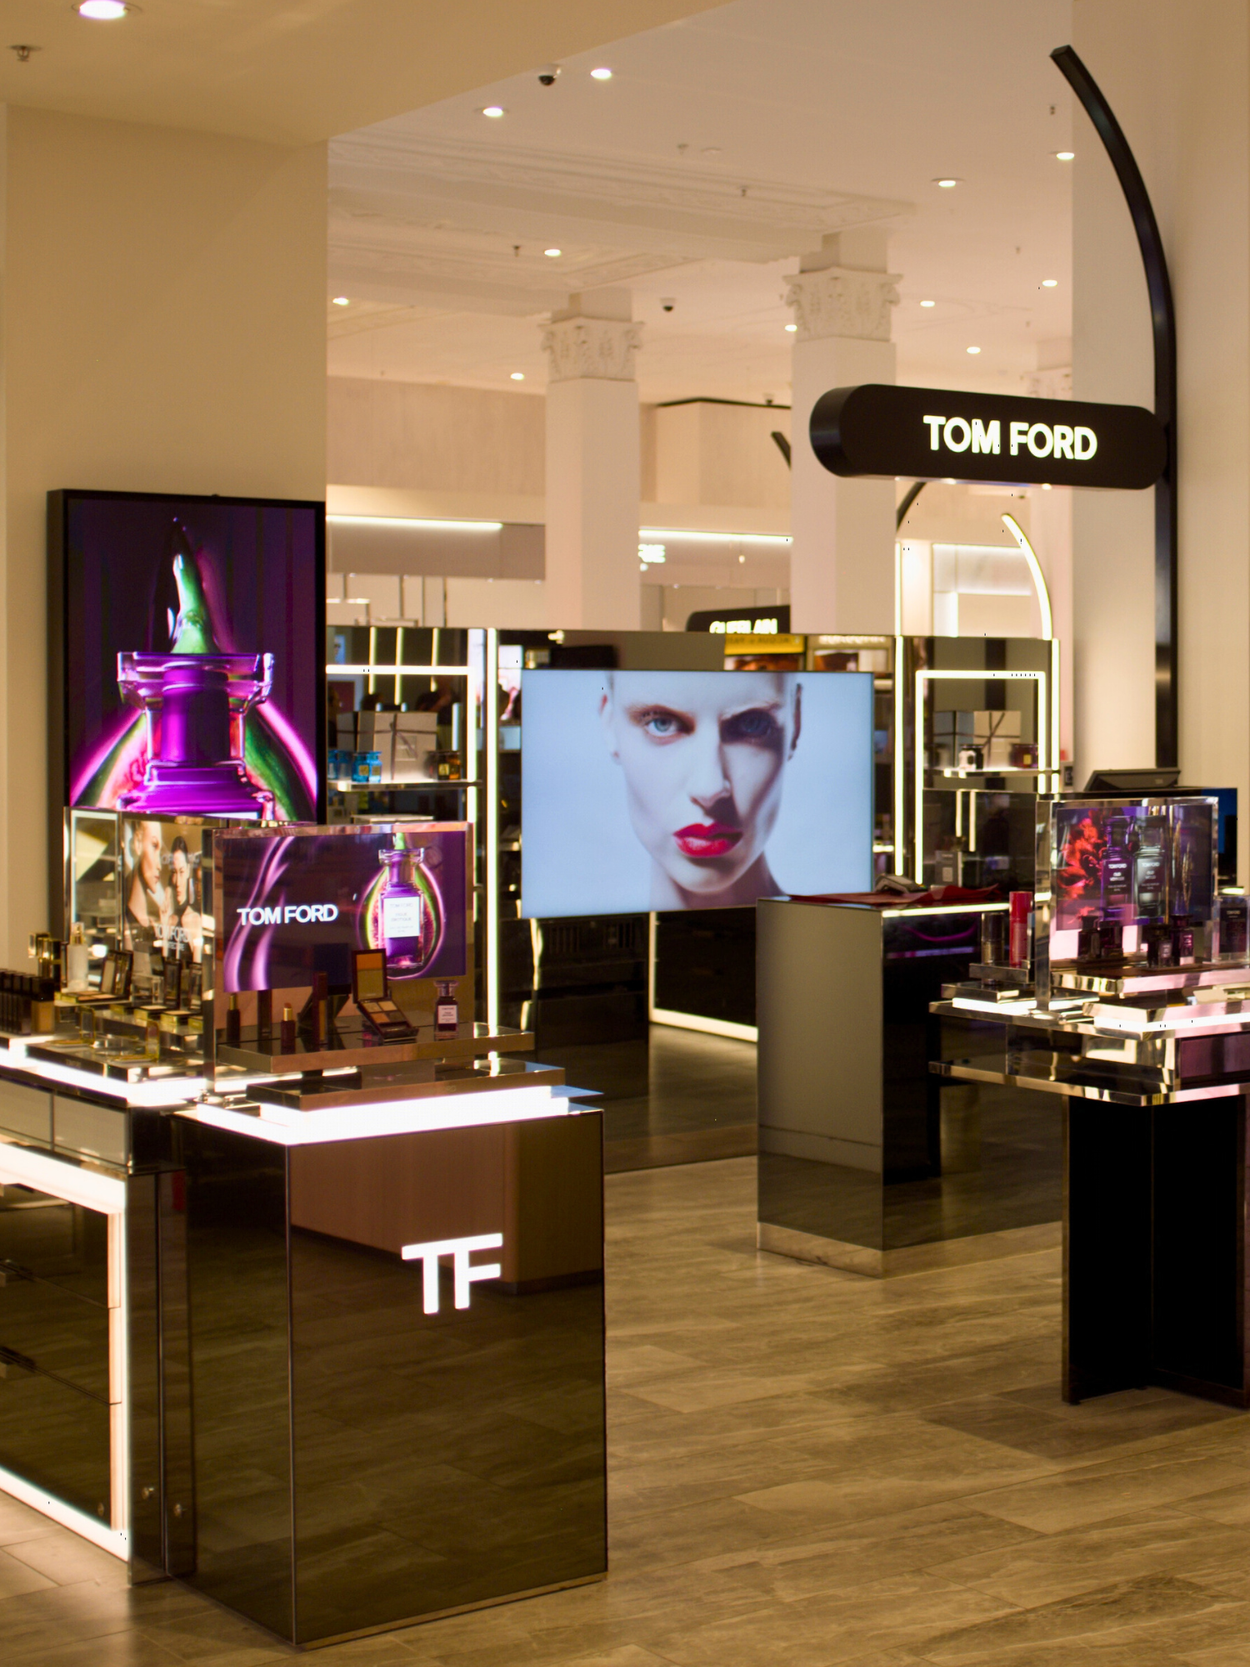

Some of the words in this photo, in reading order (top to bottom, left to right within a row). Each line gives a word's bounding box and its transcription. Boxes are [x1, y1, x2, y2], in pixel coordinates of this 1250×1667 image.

[923, 415, 1000, 455] TOM
[1009, 421, 1098, 461] FORD
[236, 907, 281, 925] TOM
[284, 904, 338, 923] FORD
[170, 926, 190, 943] FORD
[402, 1233, 503, 1314] TF
